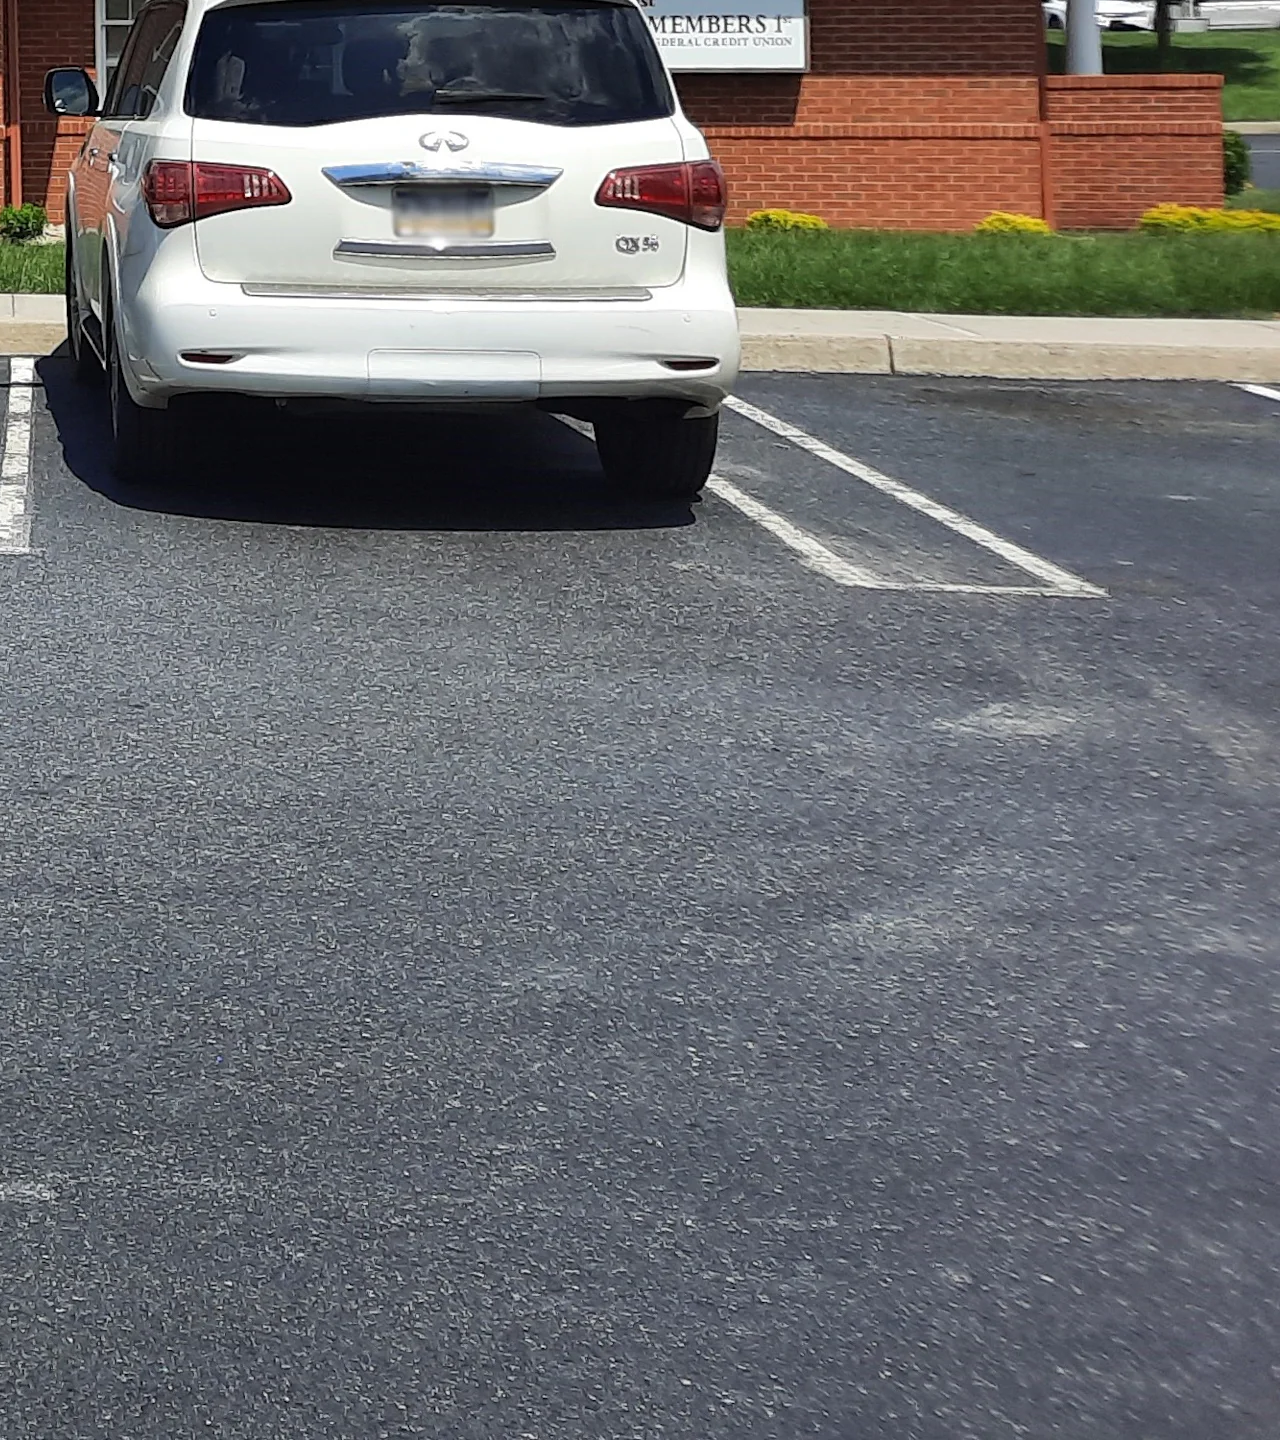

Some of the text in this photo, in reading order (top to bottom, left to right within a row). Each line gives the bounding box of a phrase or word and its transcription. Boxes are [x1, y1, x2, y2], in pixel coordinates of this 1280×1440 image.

[648, 15, 767, 34] MEMBERS
[703, 37, 749, 47] CREDIT
[752, 37, 793, 47] UNION
